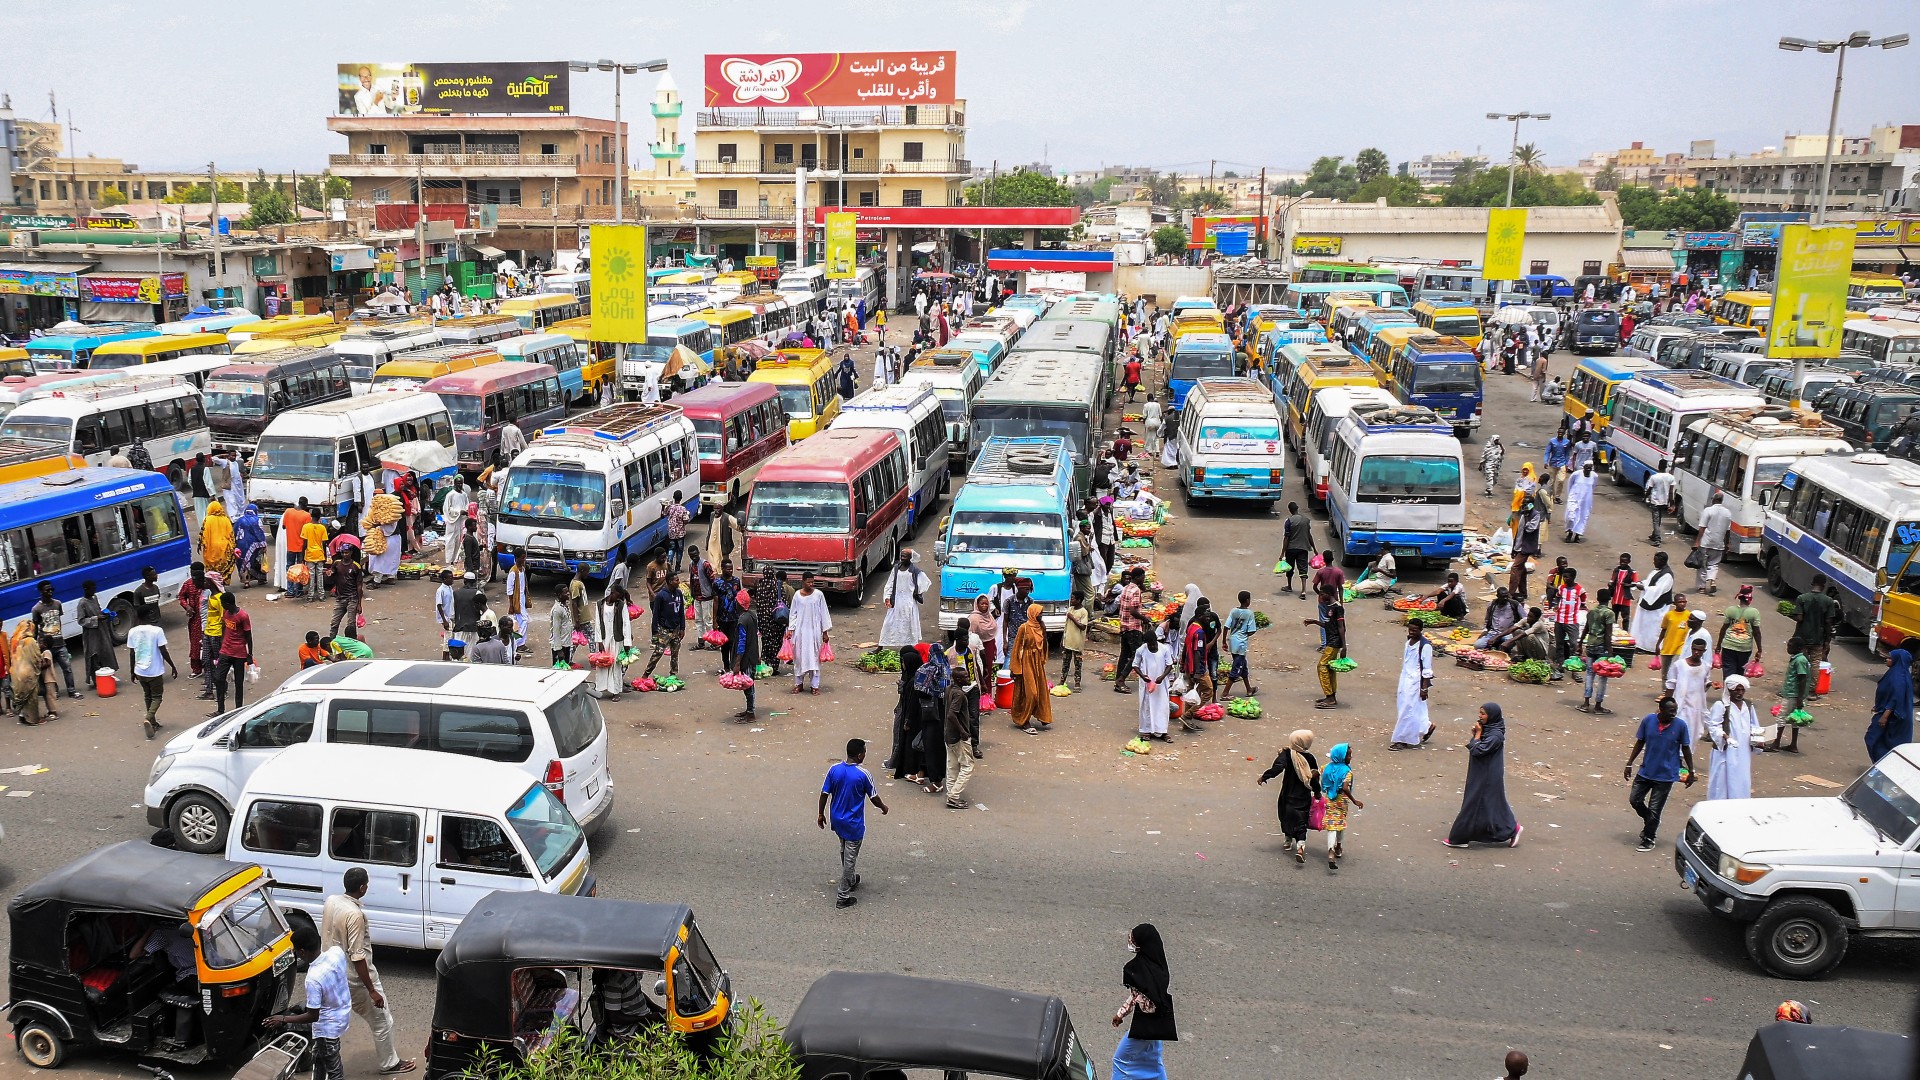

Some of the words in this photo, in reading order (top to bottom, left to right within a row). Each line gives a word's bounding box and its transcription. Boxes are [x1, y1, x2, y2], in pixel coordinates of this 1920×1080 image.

[849, 58, 884, 76] البيت
[886, 62, 907, 76] من
[909, 56, 945, 75] قريبة
[433, 77, 465, 87] ومحمص
[464, 75, 493, 87] مقشور
[739, 68, 785, 86] الفراشة
[463, 87, 472, 97] ما
[472, 87, 489, 99] نكهة
[506, 80, 549, 98] الوطنية
[857, 83, 894, 101] للقلب
[897, 78, 937, 100] وأقرب
[600, 302, 634, 320] YOMI
